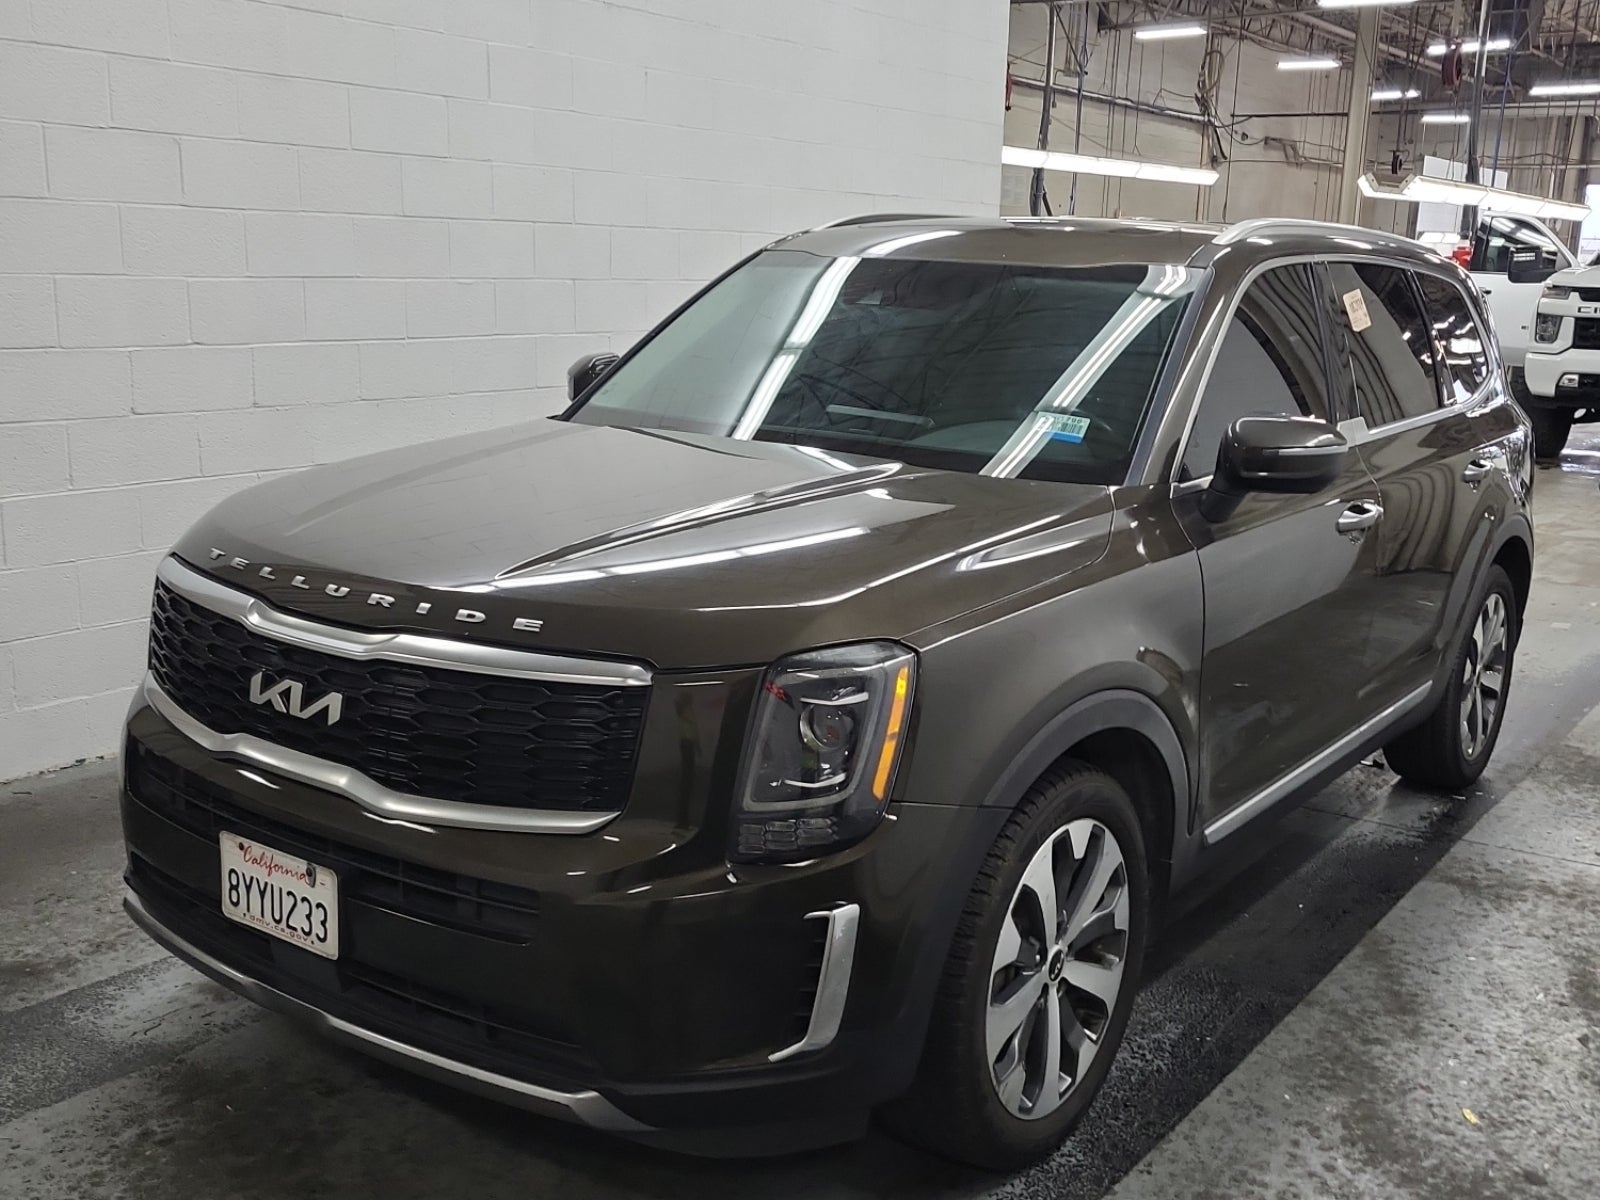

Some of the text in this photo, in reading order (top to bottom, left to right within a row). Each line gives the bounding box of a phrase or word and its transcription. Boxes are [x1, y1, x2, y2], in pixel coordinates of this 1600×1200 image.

[209, 548, 544, 632] TELLURIDE
[250, 671, 343, 726] KIA
[243, 845, 313, 887] California
[228, 867, 328, 943] 8YYU233
